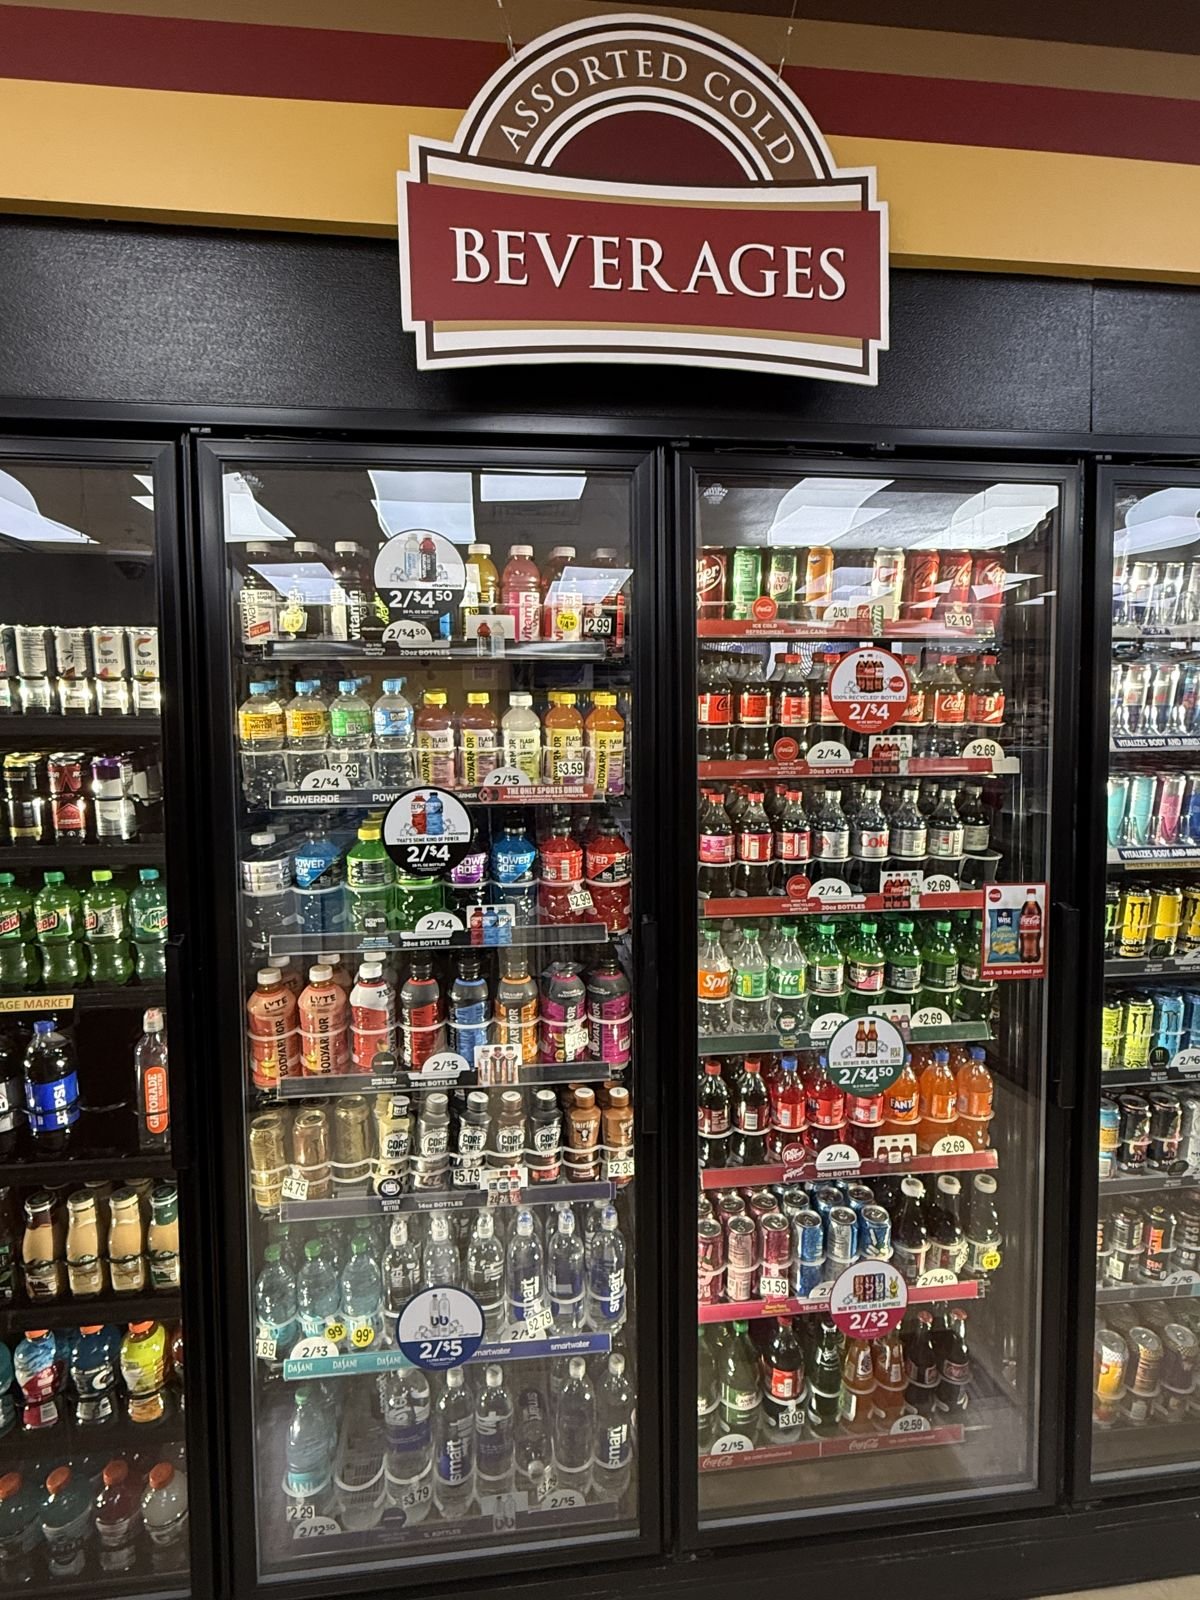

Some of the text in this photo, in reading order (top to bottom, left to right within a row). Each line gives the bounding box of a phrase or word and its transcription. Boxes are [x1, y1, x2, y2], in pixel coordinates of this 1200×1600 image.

[499, 48, 796, 165] ASSORTED COLD
[448, 226, 847, 301] BEVERAGES
[848, 703, 890, 720] 2/$4
[1116, 739, 1148, 747] VITALIZES
[1147, 738, 1166, 746] BODY
[817, 749, 842, 760] 2/$4
[972, 744, 996, 757] $2.69
[558, 762, 583, 776] $3.59
[312, 778, 339, 789] 2/$4
[493, 775, 520, 786] 2/$5
[537, 786, 563, 794] SPORTS
[285, 794, 340, 804] POWERADE
[406, 844, 451, 863] 2/$4
[1121, 849, 1186, 859] VITALIZES BODY AND
[818, 885, 843, 896] 2/$4
[926, 879, 951, 892] $2.69
[569, 893, 591, 908] $2.99
[426, 919, 453, 930] 2/$4
[419, 939, 450, 947] BOTTLES
[23, 998, 71, 1008] MARKET
[918, 1012, 943, 1026] $2.69
[433, 1060, 458, 1071] 2/$5
[427, 1079, 458, 1087] BOTTLES
[462, 1133, 482, 1144] CORE
[941, 1140, 966, 1154] $2.69
[826, 1151, 850, 1162] 2/$4
[454, 1169, 480, 1182] $5.79
[832, 1169, 861, 1177] BOTTLES
[283, 1179, 306, 1197] $4.79
[433, 1200, 463, 1208] BOTTLES
[761, 1279, 788, 1295] $1.59
[528, 1311, 552, 1332] $2.79
[849, 1311, 889, 1330] 2/$2
[419, 1340, 463, 1359] 2/$5
[551, 1339, 590, 1350] smartwater
[302, 1345, 329, 1358] 2/$3
[332, 1359, 358, 1370] DASANI
[377, 1355, 402, 1366] DASANI
[288, 1363, 313, 1374] DASANI
[780, 1412, 804, 1426] $3.09
[899, 1419, 923, 1432] $2.59
[720, 1441, 744, 1453] 2/$5
